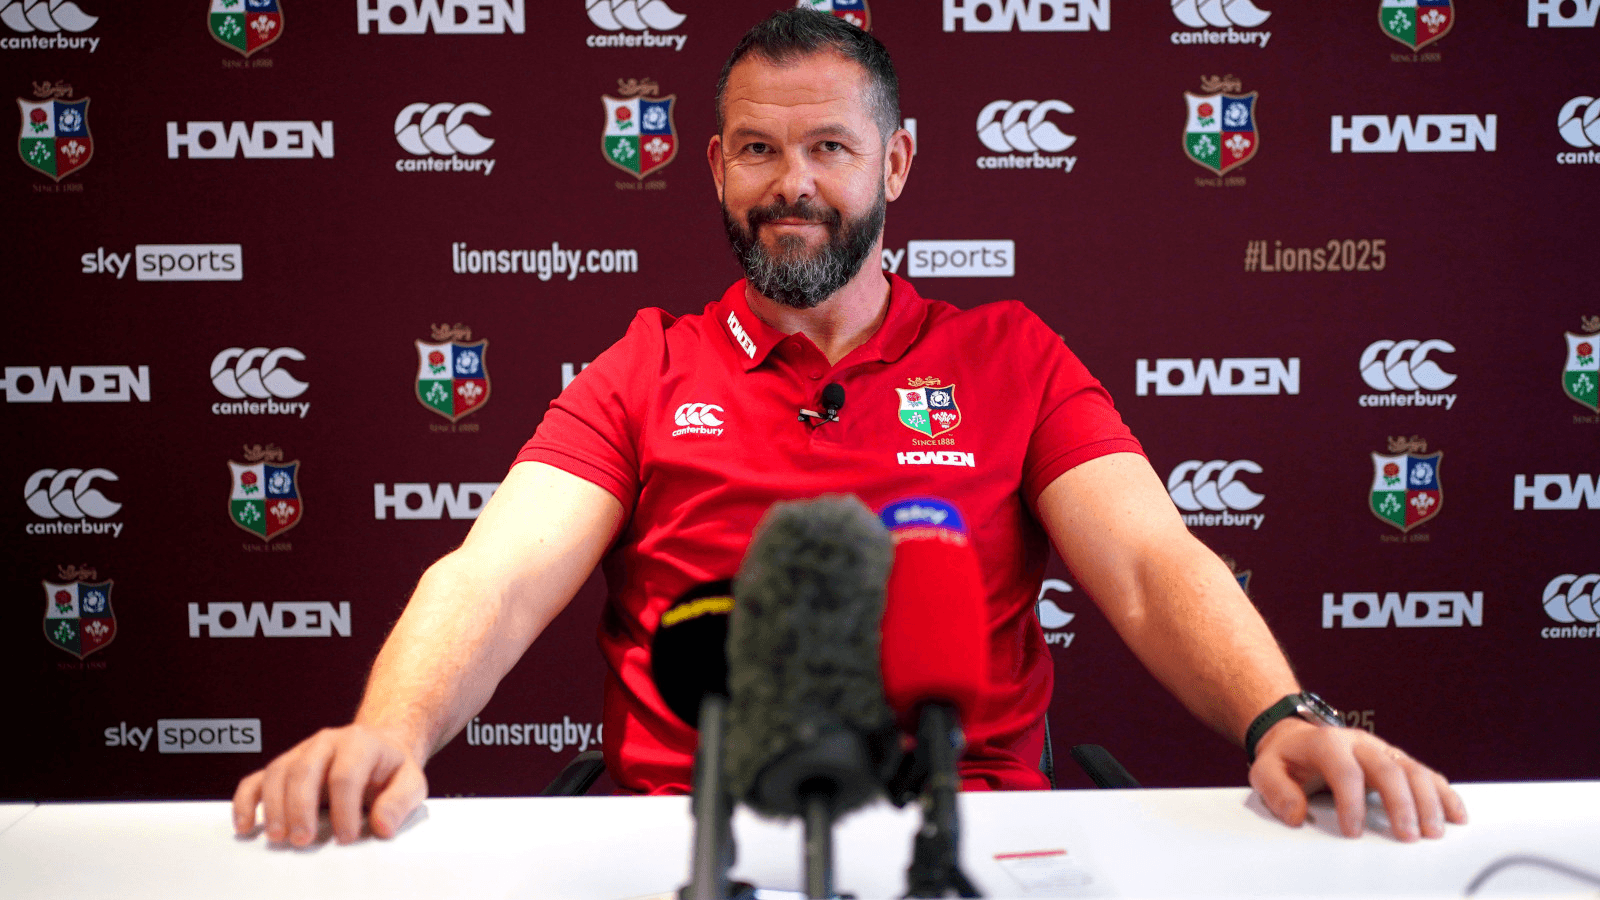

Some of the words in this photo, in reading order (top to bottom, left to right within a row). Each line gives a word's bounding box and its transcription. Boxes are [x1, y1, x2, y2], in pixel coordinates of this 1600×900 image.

[357, 0, 526, 34] HOWDEN
[943, 0, 1111, 32] HOWDEN
[0, 33, 100, 53] canterbury
[586, 31, 688, 52] canterbury
[1171, 28, 1271, 49] canterbury
[167, 121, 335, 159] HOWDEN
[1331, 114, 1498, 153] HOWDEN
[395, 155, 496, 176] canterbury
[977, 151, 1077, 173] canterbury
[81, 248, 131, 279] sky
[142, 250, 236, 276] sports
[452, 242, 639, 282] lionsrugby.com
[914, 247, 1008, 272] sports
[1244, 239, 1386, 272] #Lions2025
[727, 310, 757, 359] HOWDEN
[1135, 358, 1301, 396] HOWDEN
[211, 398, 310, 419] canterbury
[1358, 389, 1457, 411] canterbury
[672, 424, 724, 437] canterbury
[938, 437, 956, 446] 1888
[896, 451, 976, 468] HOWDEN
[25, 517, 124, 538] canterbury
[187, 601, 352, 638] HOWDEN
[1322, 591, 1484, 629] HOWDEN
[104, 722, 153, 752] sky
[163, 724, 255, 749] sports
